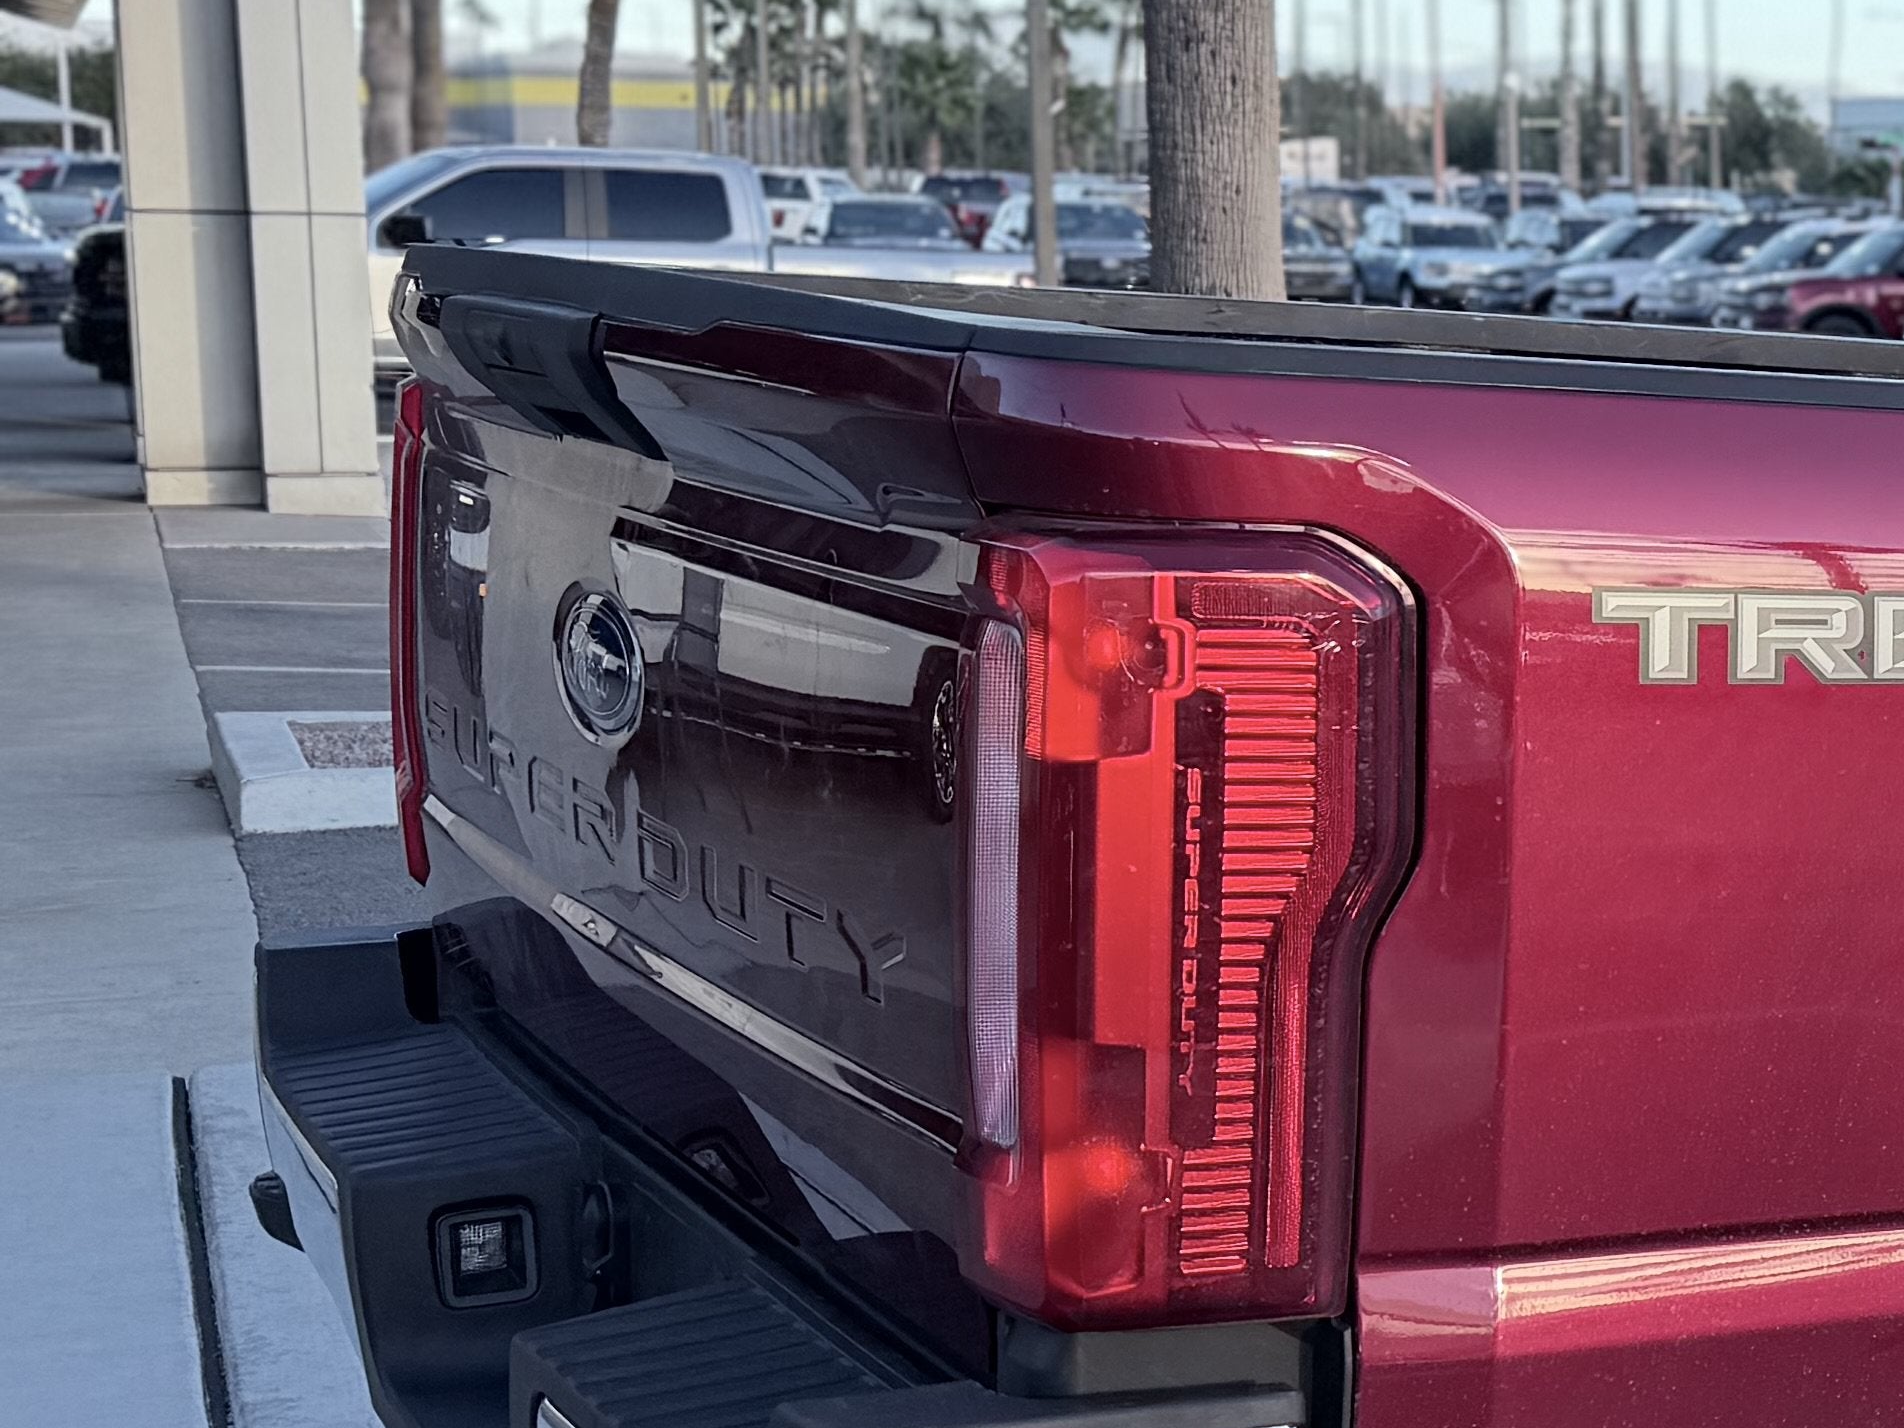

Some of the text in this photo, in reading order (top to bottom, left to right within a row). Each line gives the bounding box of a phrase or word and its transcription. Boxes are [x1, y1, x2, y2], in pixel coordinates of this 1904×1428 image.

[425, 690, 906, 1008] SUPER DUTY
[1178, 767, 1203, 1097] SUPER DUTY
